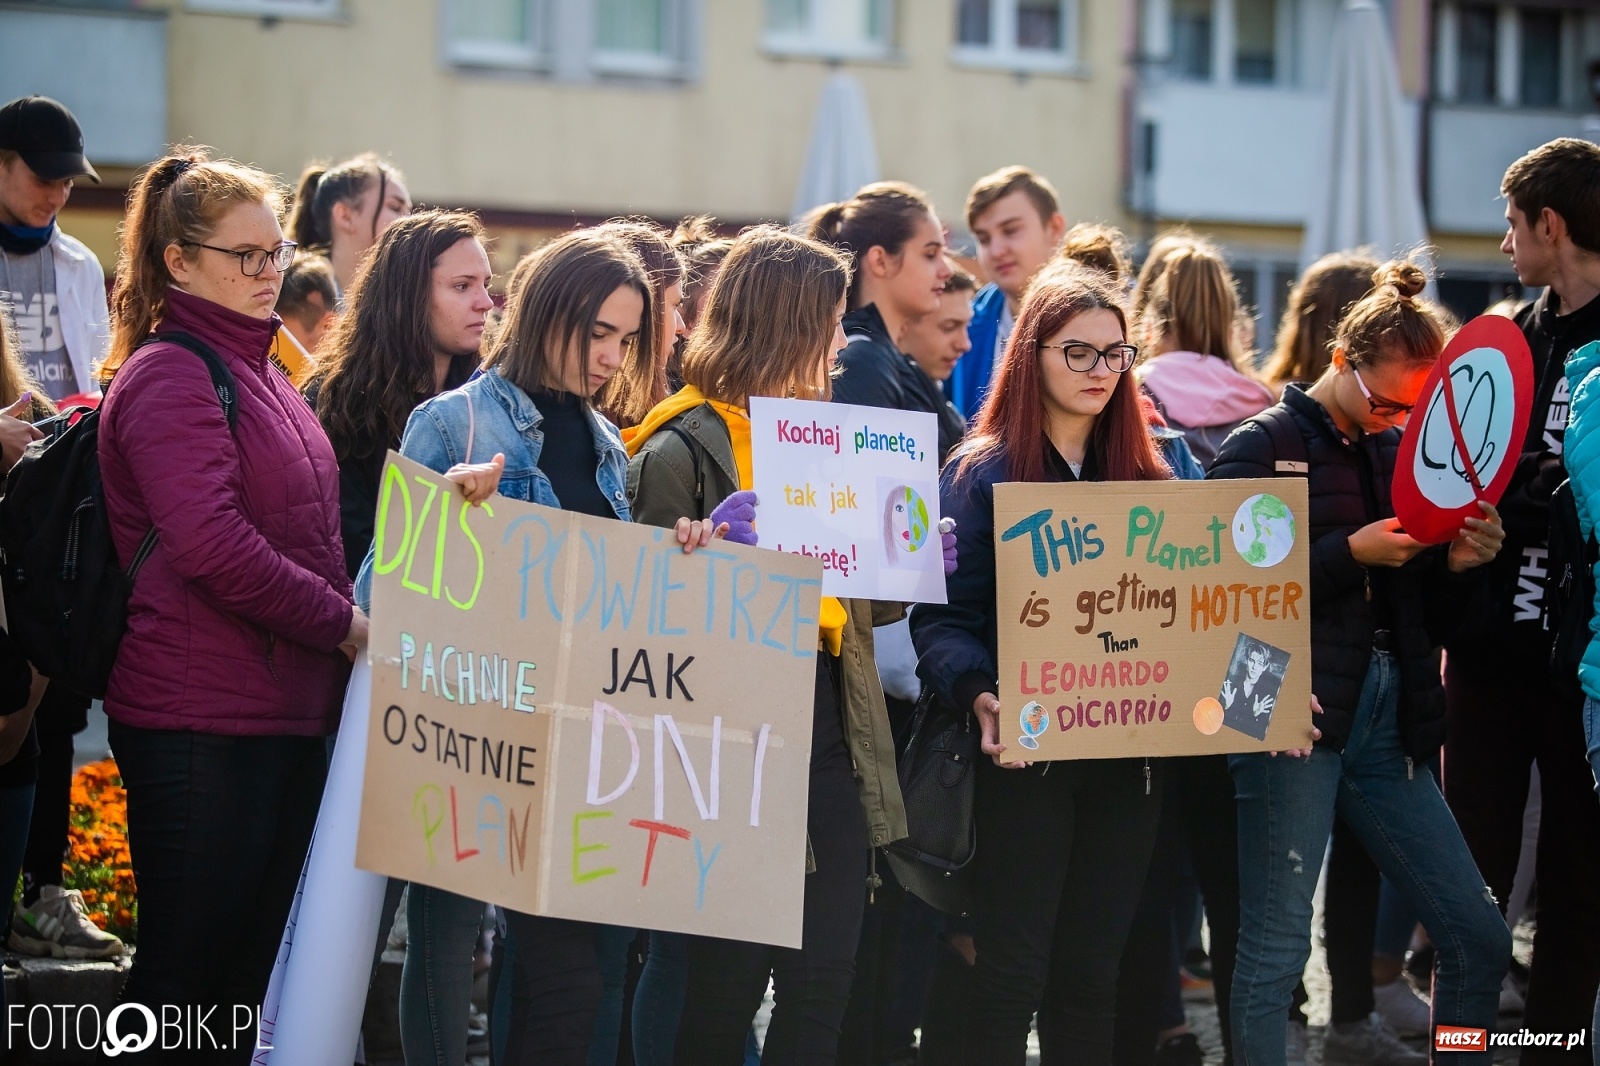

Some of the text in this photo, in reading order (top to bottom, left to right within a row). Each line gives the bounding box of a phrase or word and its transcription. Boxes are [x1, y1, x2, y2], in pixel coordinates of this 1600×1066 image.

[777, 419, 924, 462] Kochaj planetę,
[784, 482, 858, 515] tak jak
[1125, 505, 1228, 571] Planet
[1019, 572, 1303, 635] is getting HOTTER
[1097, 631, 1139, 654] Than
[400, 631, 696, 714] PACHNIE JAK
[1020, 660, 1170, 695] LEONARDO
[382, 700, 772, 828] OSTATNIE DNI
